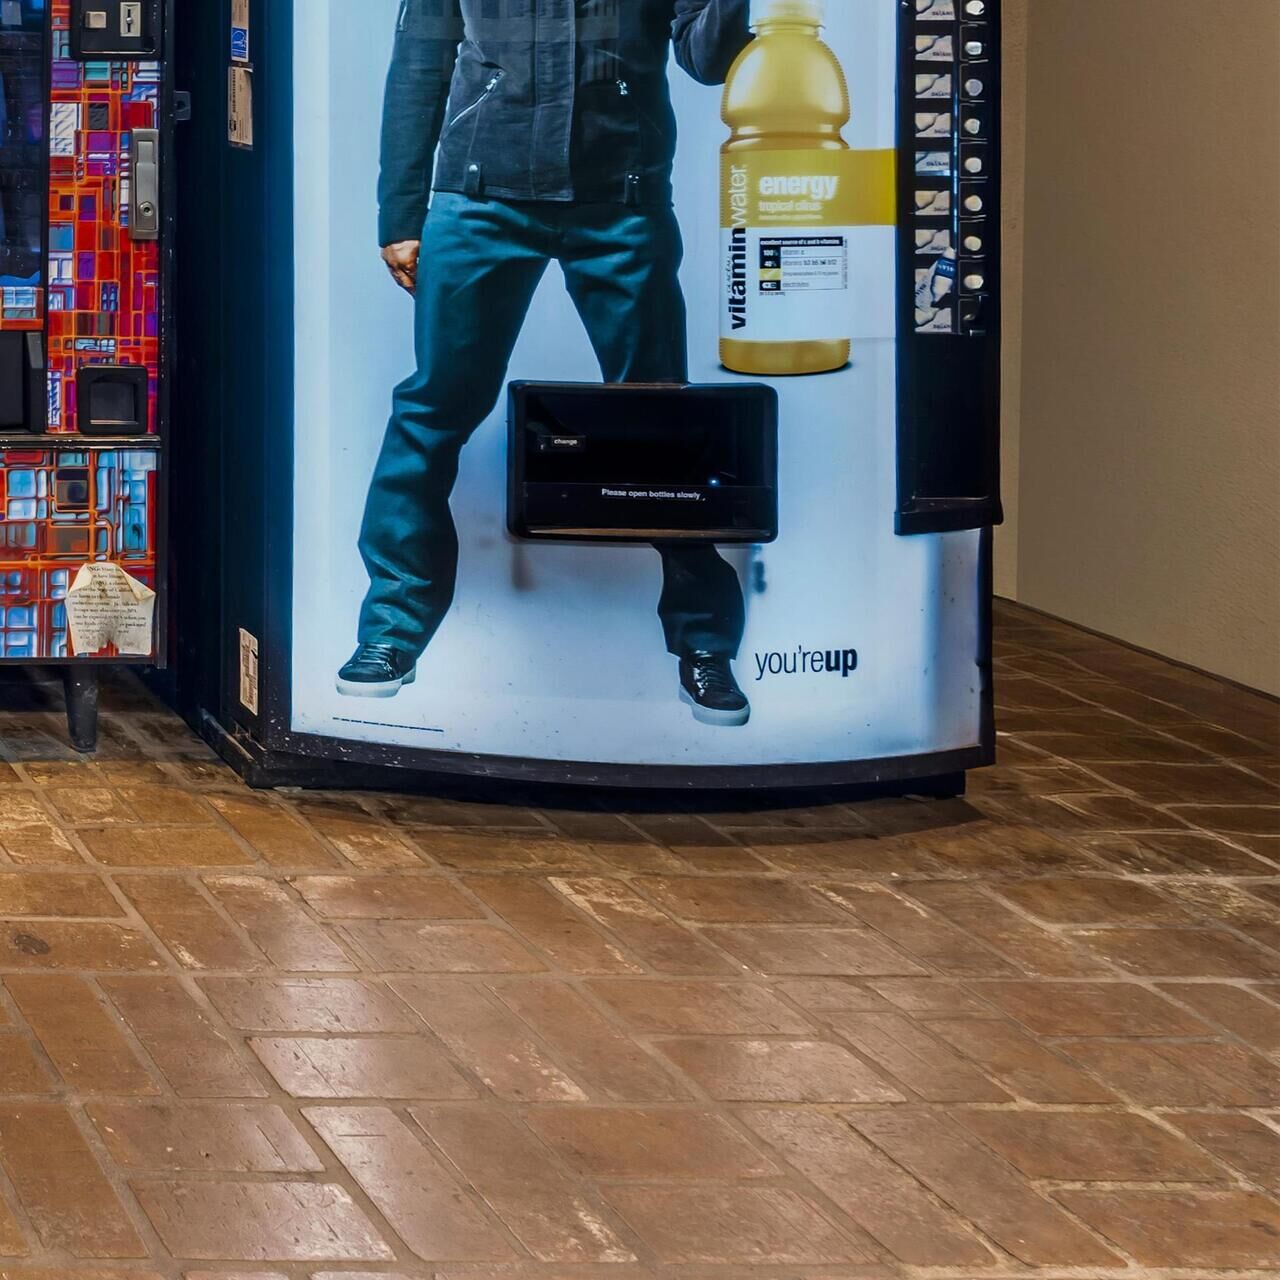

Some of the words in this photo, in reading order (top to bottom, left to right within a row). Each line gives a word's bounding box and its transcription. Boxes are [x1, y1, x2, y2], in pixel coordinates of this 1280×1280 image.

[759, 175, 839, 201] energy
[759, 201, 794, 213] tropical
[554, 438, 578, 446] change
[601, 488, 627, 497] Please
[628, 490, 648, 498] open
[649, 490, 676, 498] bottles
[676, 492, 701, 500] slowly
[755, 644, 858, 681] you'reup
